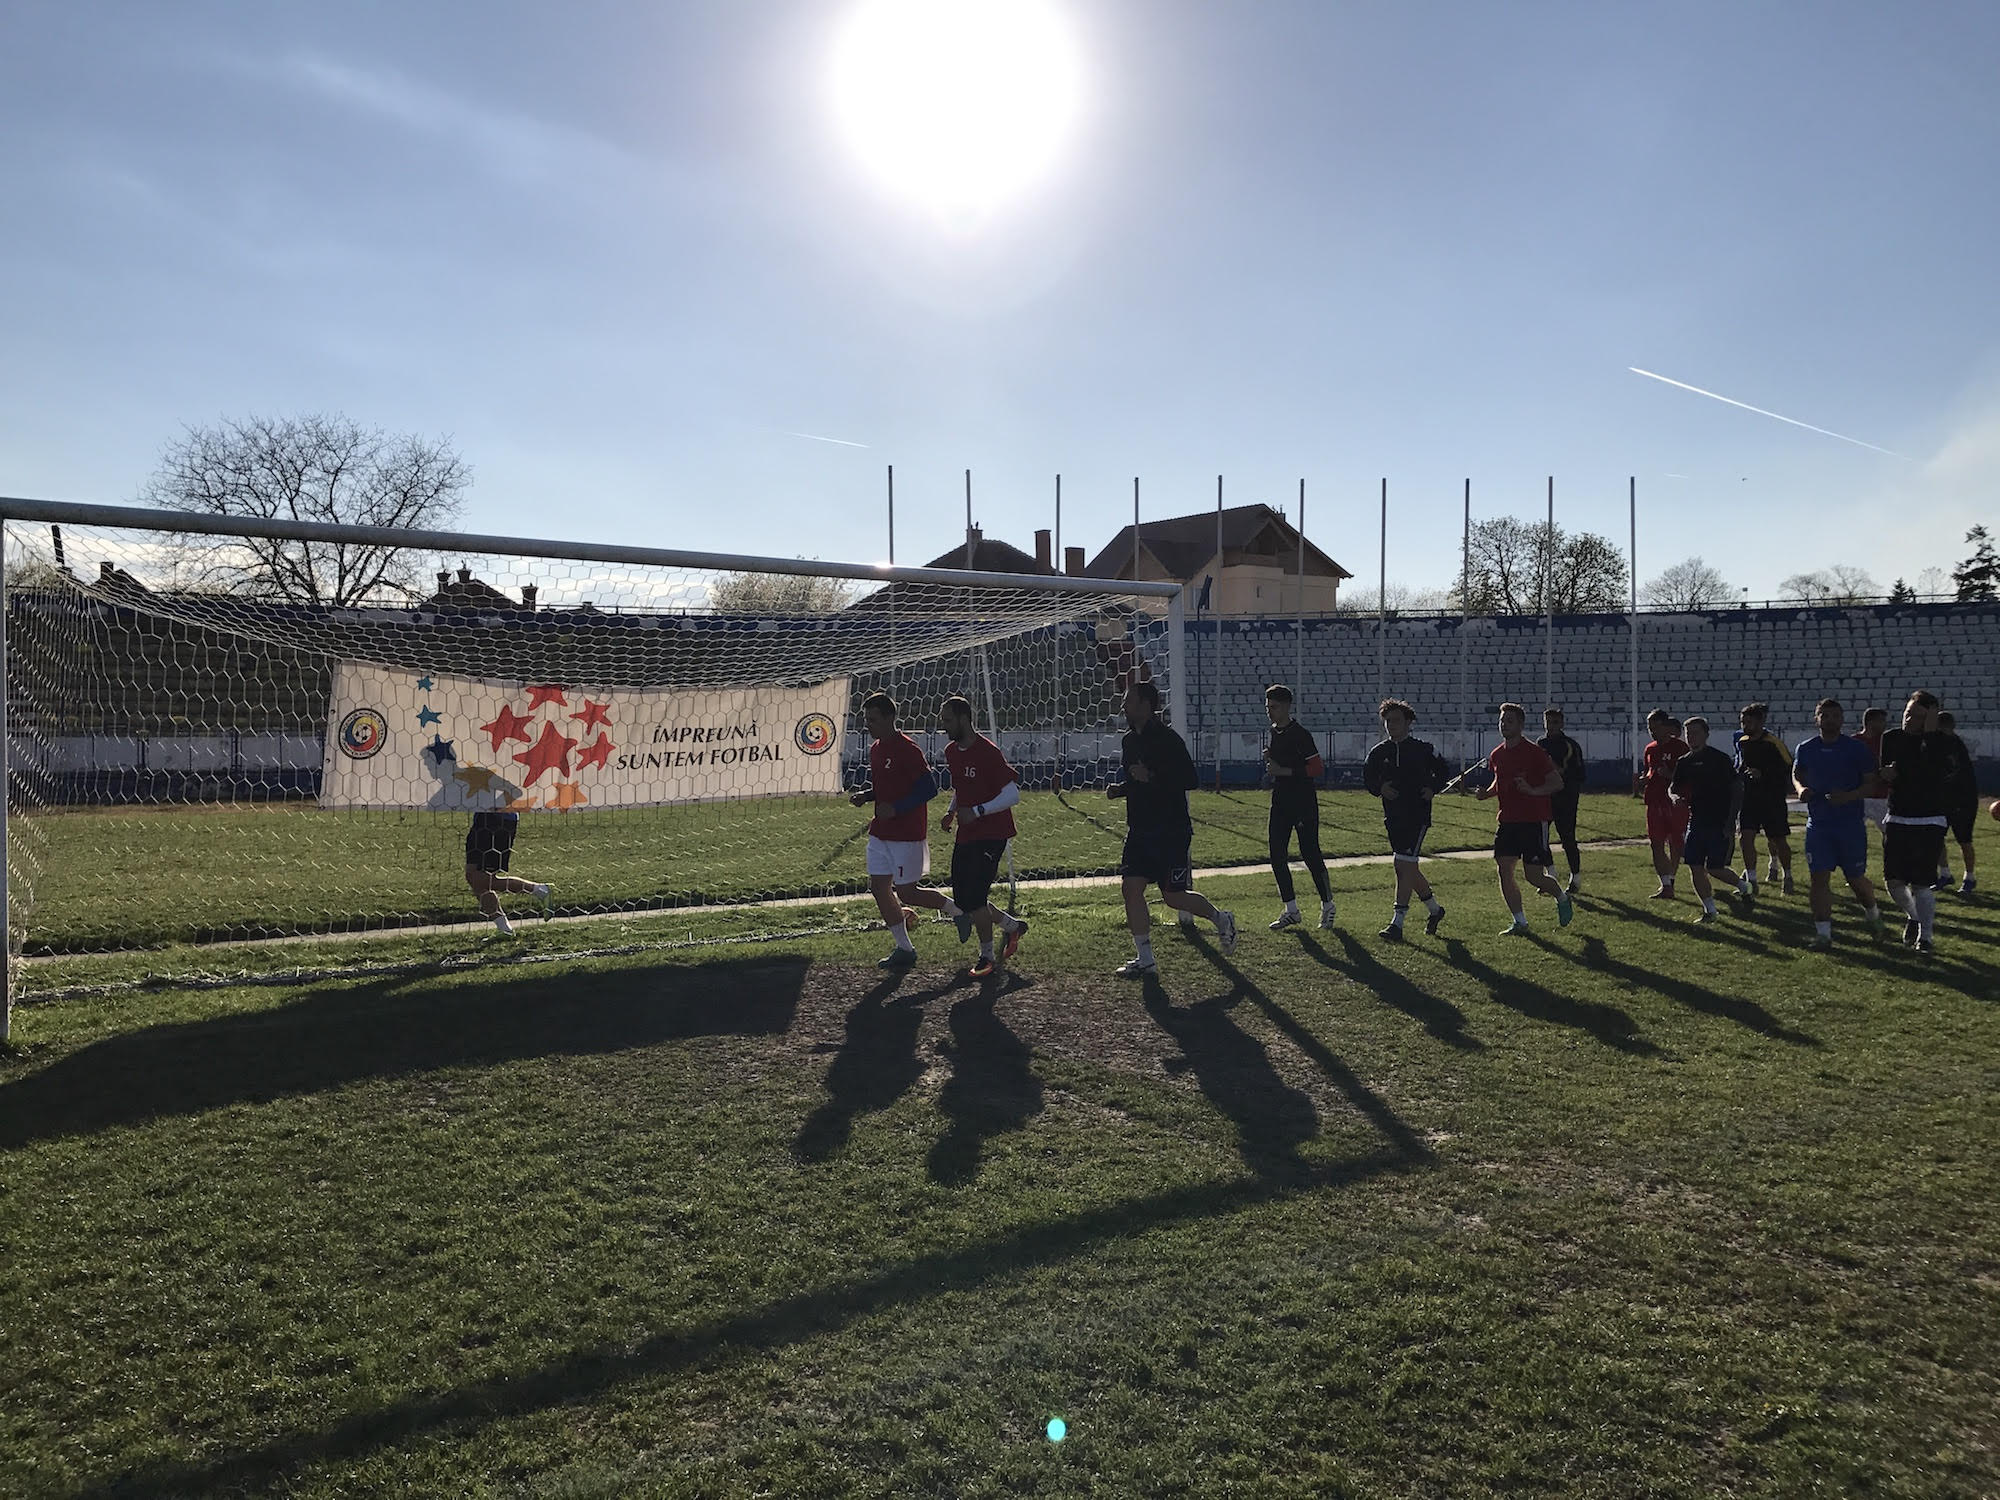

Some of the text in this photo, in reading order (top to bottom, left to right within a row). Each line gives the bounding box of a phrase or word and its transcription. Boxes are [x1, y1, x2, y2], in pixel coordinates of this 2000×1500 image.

[653, 720, 758, 744] ÎMPREUNĂ
[616, 744, 784, 771] SUNTEM FOTBAL
[884, 758, 892, 769] 2
[964, 766, 977, 778] 16
